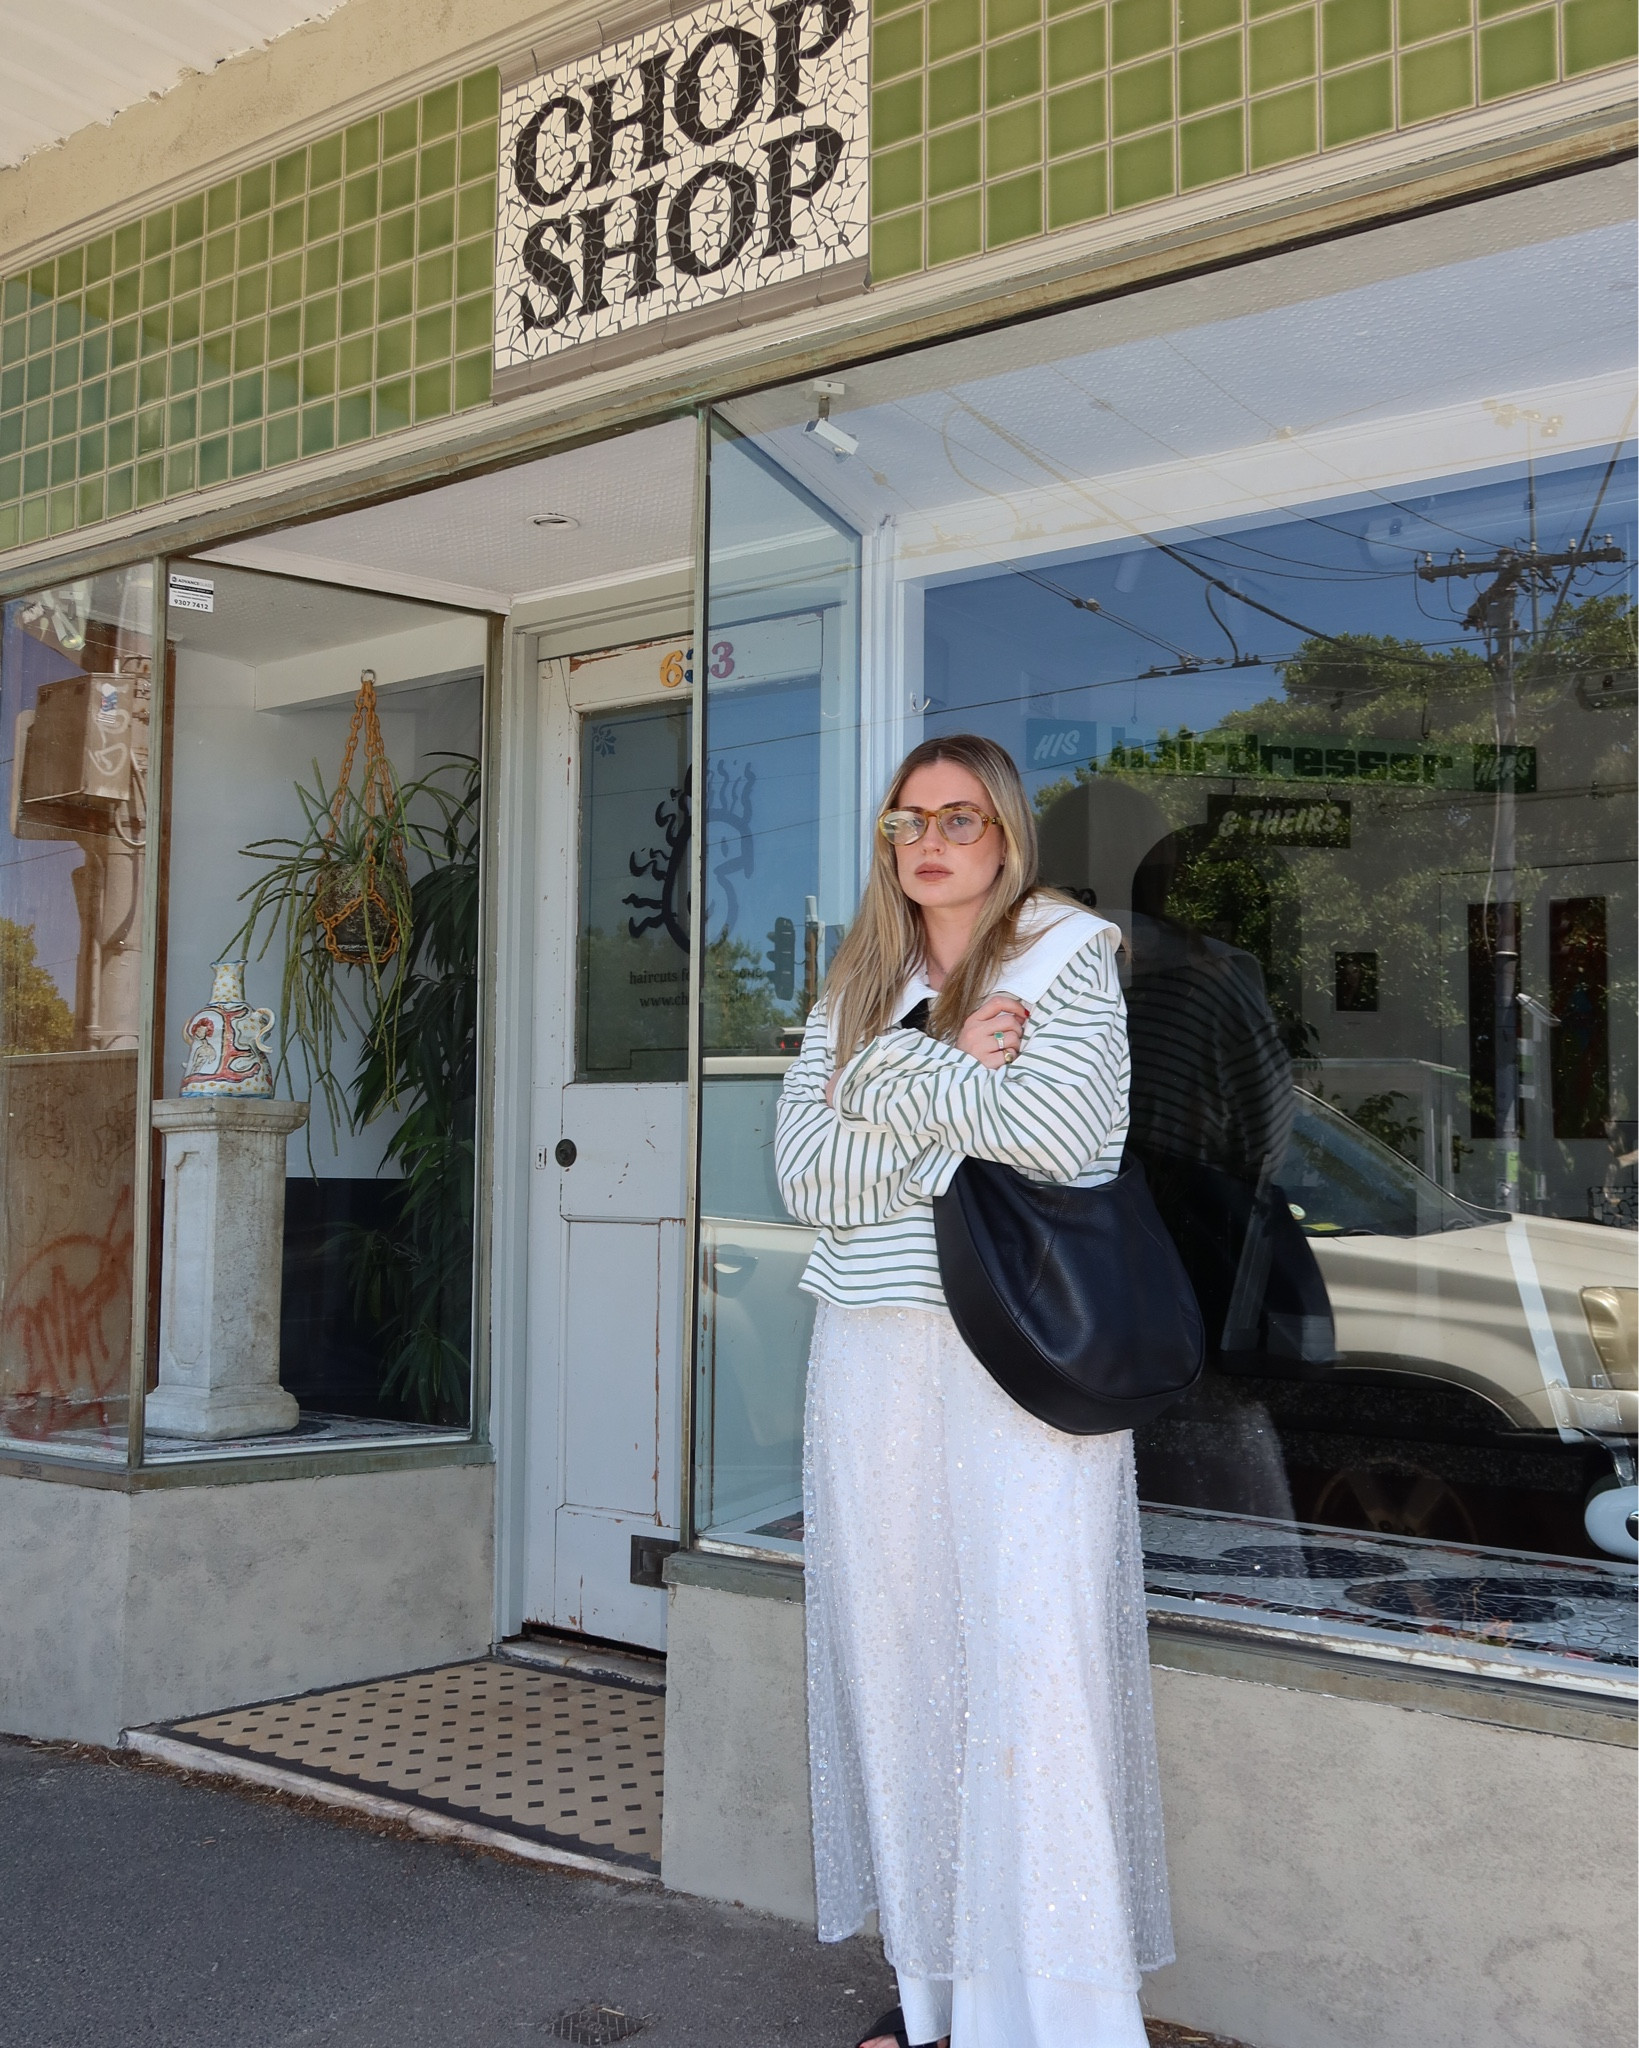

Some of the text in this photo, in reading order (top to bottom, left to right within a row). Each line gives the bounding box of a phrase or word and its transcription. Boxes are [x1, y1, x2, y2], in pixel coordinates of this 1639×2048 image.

[514, 0, 854, 206] CHOP
[521, 126, 844, 332] SHOP
[1033, 727, 1530, 783] HIS hairdresser HERS
[1218, 805, 1342, 837] & THEIRS
[629, 968, 678, 985] haircuts
